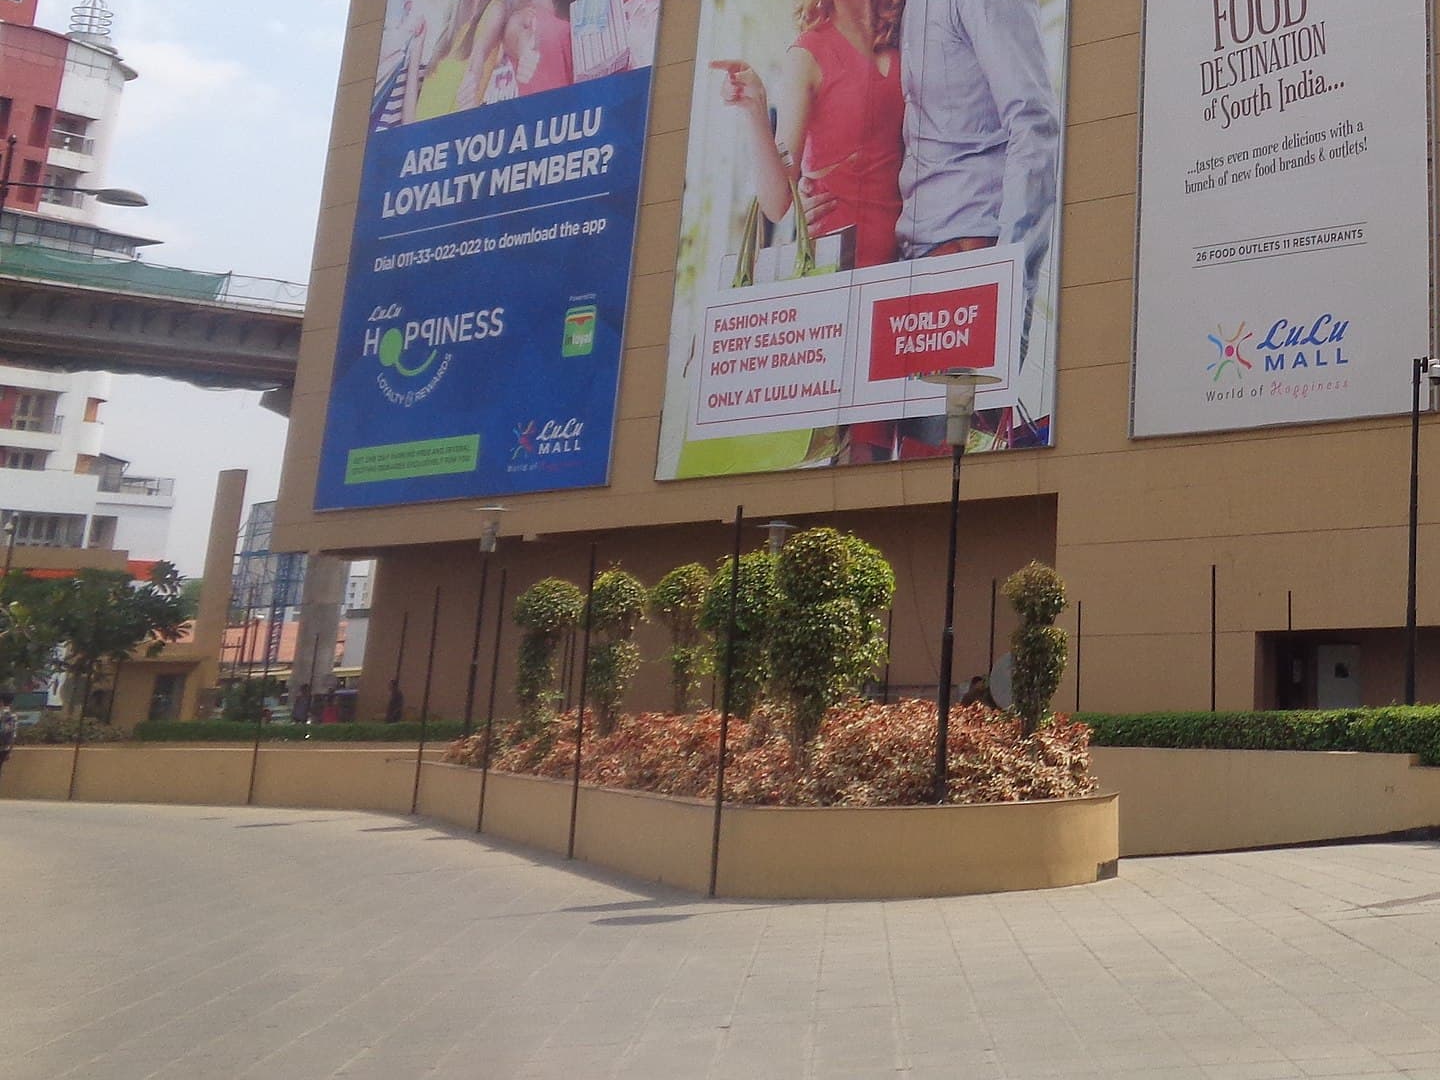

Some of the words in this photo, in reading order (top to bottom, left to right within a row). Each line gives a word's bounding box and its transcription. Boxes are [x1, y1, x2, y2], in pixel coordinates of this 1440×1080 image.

[1200, 21, 1326, 96] DESTINATION
[1203, 98, 1217, 121] of
[1221, 83, 1272, 129] South
[1278, 69, 1344, 112] India...
[400, 142, 449, 177] ARE
[455, 129, 504, 165] YOU
[508, 124, 527, 154] A
[534, 107, 602, 148] LULU
[1227, 150, 1249, 165] even
[1252, 143, 1279, 159] more
[1282, 130, 1326, 151] delicious
[1329, 120, 1354, 139] with
[1357, 122, 1364, 132] a
[1185, 178, 1215, 194] bunch
[1218, 170, 1228, 187] of
[1231, 170, 1252, 184] new
[1255, 159, 1276, 178] food
[1279, 150, 1316, 172] brands
[1319, 147, 1326, 162] &
[1329, 136, 1368, 159] outlets!
[382, 171, 485, 218] LOYALTY
[490, 144, 614, 196] MEMBER?
[374, 254, 395, 272] Dial
[397, 238, 481, 267] 011-33-022-022
[484, 238, 496, 251] to
[499, 223, 557, 249] download
[559, 220, 579, 237] the
[582, 218, 606, 236] app
[1196, 252, 1207, 263] 26
[1209, 247, 1236, 260] FOOD
[1238, 240, 1281, 256] OUTLETS
[1283, 239, 1290, 249] 11
[1292, 228, 1363, 248] RESTAURANTS
[714, 312, 768, 333] FASHION
[771, 309, 797, 325] FOR
[889, 310, 951, 333] WORLD
[954, 304, 979, 326] OF
[712, 336, 752, 354] EVERY
[754, 328, 805, 348] SEASON
[809, 323, 843, 340] WITH
[895, 328, 970, 355] FASHION
[711, 360, 736, 376] HOT
[740, 356, 768, 373] NEW
[771, 349, 826, 368] BRANDS,
[1265, 347, 1349, 372] MALL
[708, 390, 743, 408] ONLY
[745, 388, 762, 404] AT
[764, 384, 798, 402] LULU
[801, 379, 841, 398] MALL.
[1206, 386, 1243, 402] World
[1250, 384, 1264, 397] of
[1270, 379, 1350, 399] Happiness
[538, 440, 581, 454] MALL
